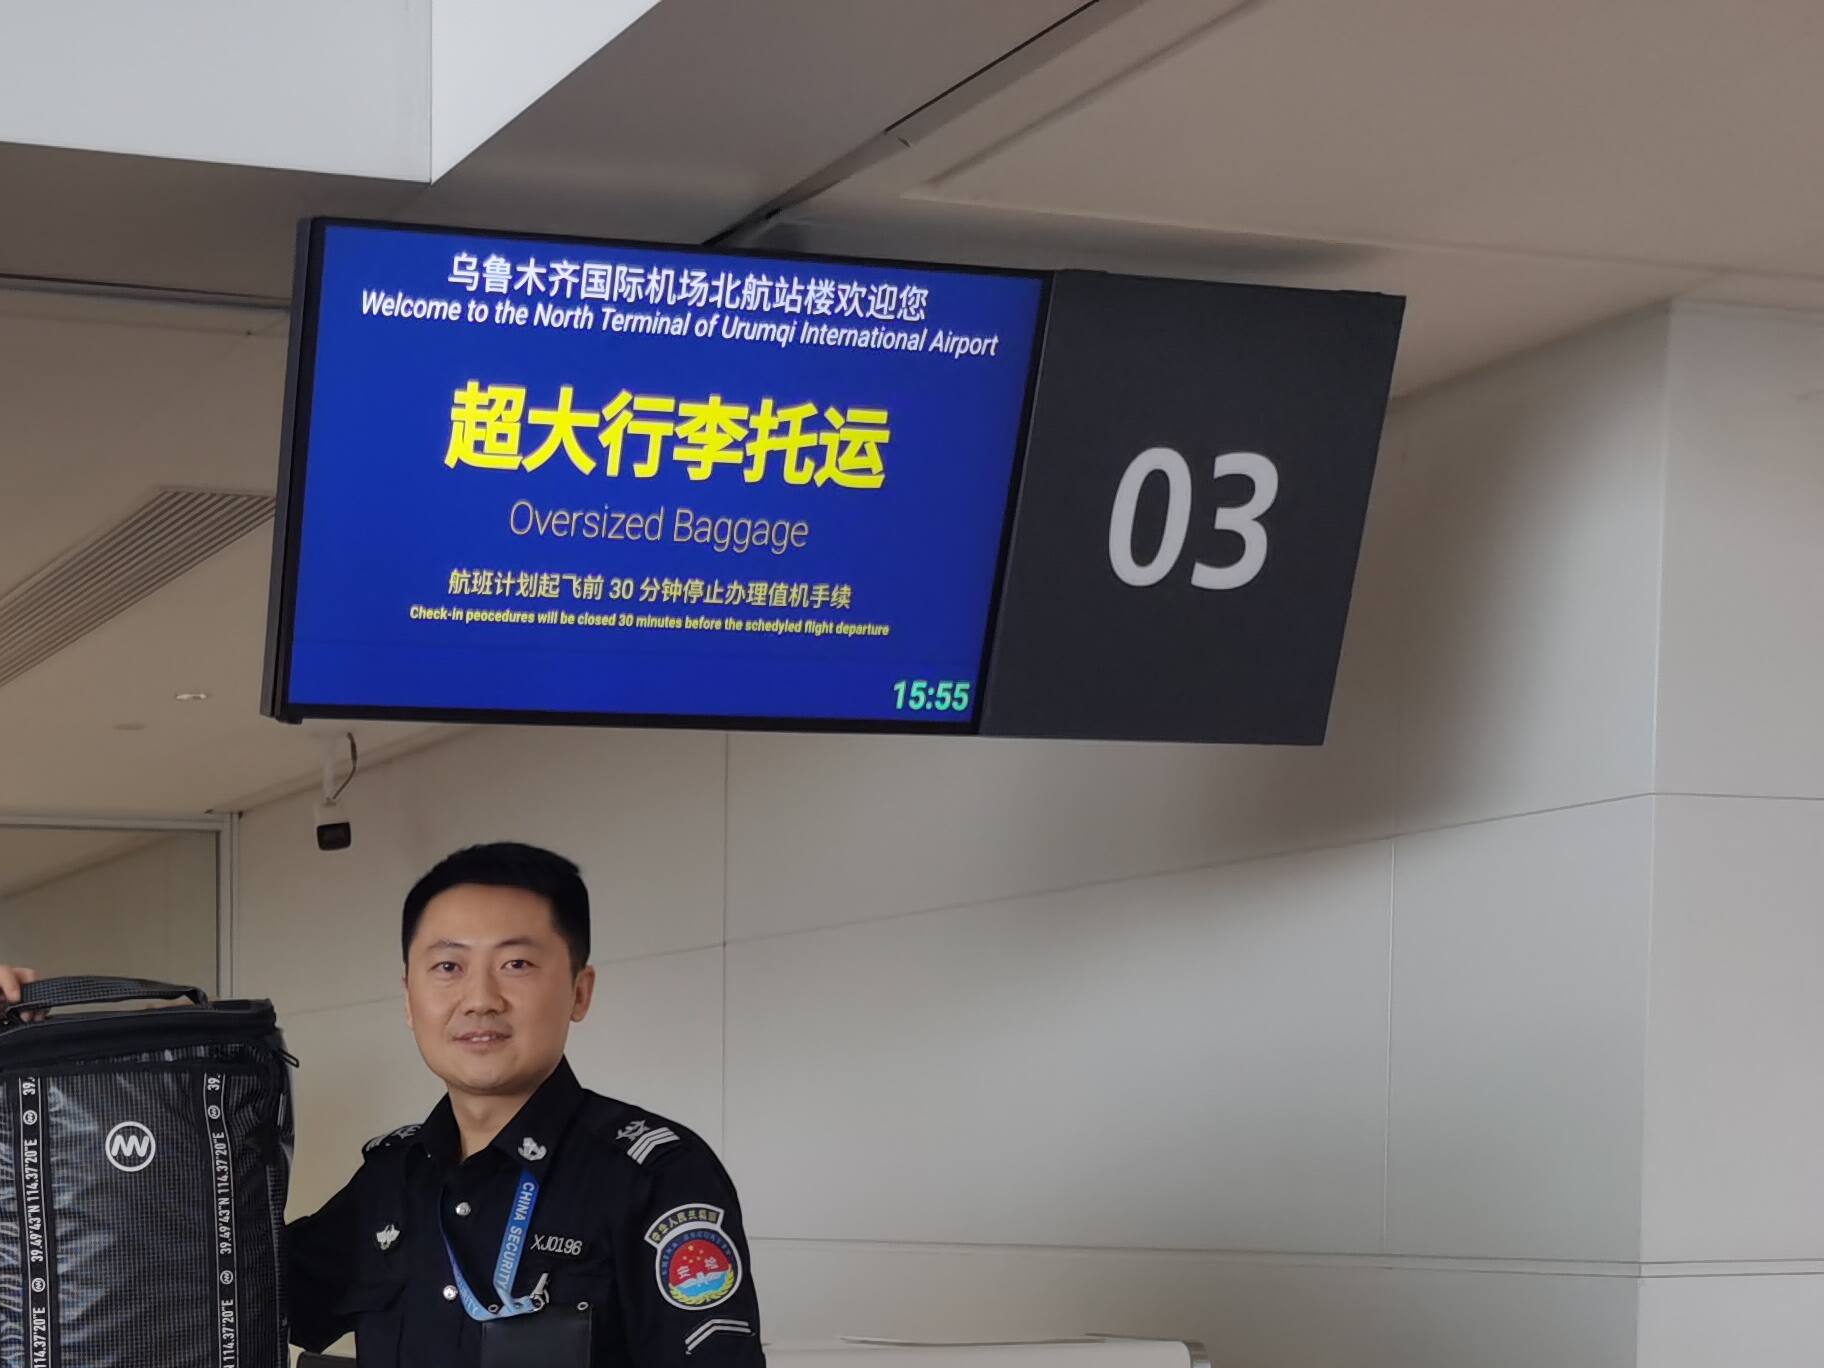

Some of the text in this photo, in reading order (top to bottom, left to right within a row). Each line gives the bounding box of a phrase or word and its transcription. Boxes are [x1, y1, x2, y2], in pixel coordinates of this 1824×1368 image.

[448, 252, 929, 322] 乌鲁木齐国际机场北航站楼欢迎您
[362, 289, 999, 359] Welcome to the North Terminal of Urumqi International Airport
[444, 380, 891, 489] 超大行李托运
[509, 499, 810, 555] Oversized Baggage
[1108, 446, 1279, 590] 03
[448, 568, 853, 609] 航班计划起飞前 30 分钟停止办理值机手续
[537, 610, 558, 625] will
[560, 612, 575, 625] be
[577, 613, 616, 627] closed
[618, 614, 634, 627] 30
[636, 614, 682, 629] minutes
[685, 615, 722, 630] before
[724, 617, 743, 631] the
[804, 620, 834, 636] flight
[836, 622, 890, 637] departure
[893, 680, 971, 711] 15:55
[497, 1182, 535, 1290] CHINA SECURITY
[530, 1233, 583, 1256] XJ0196
